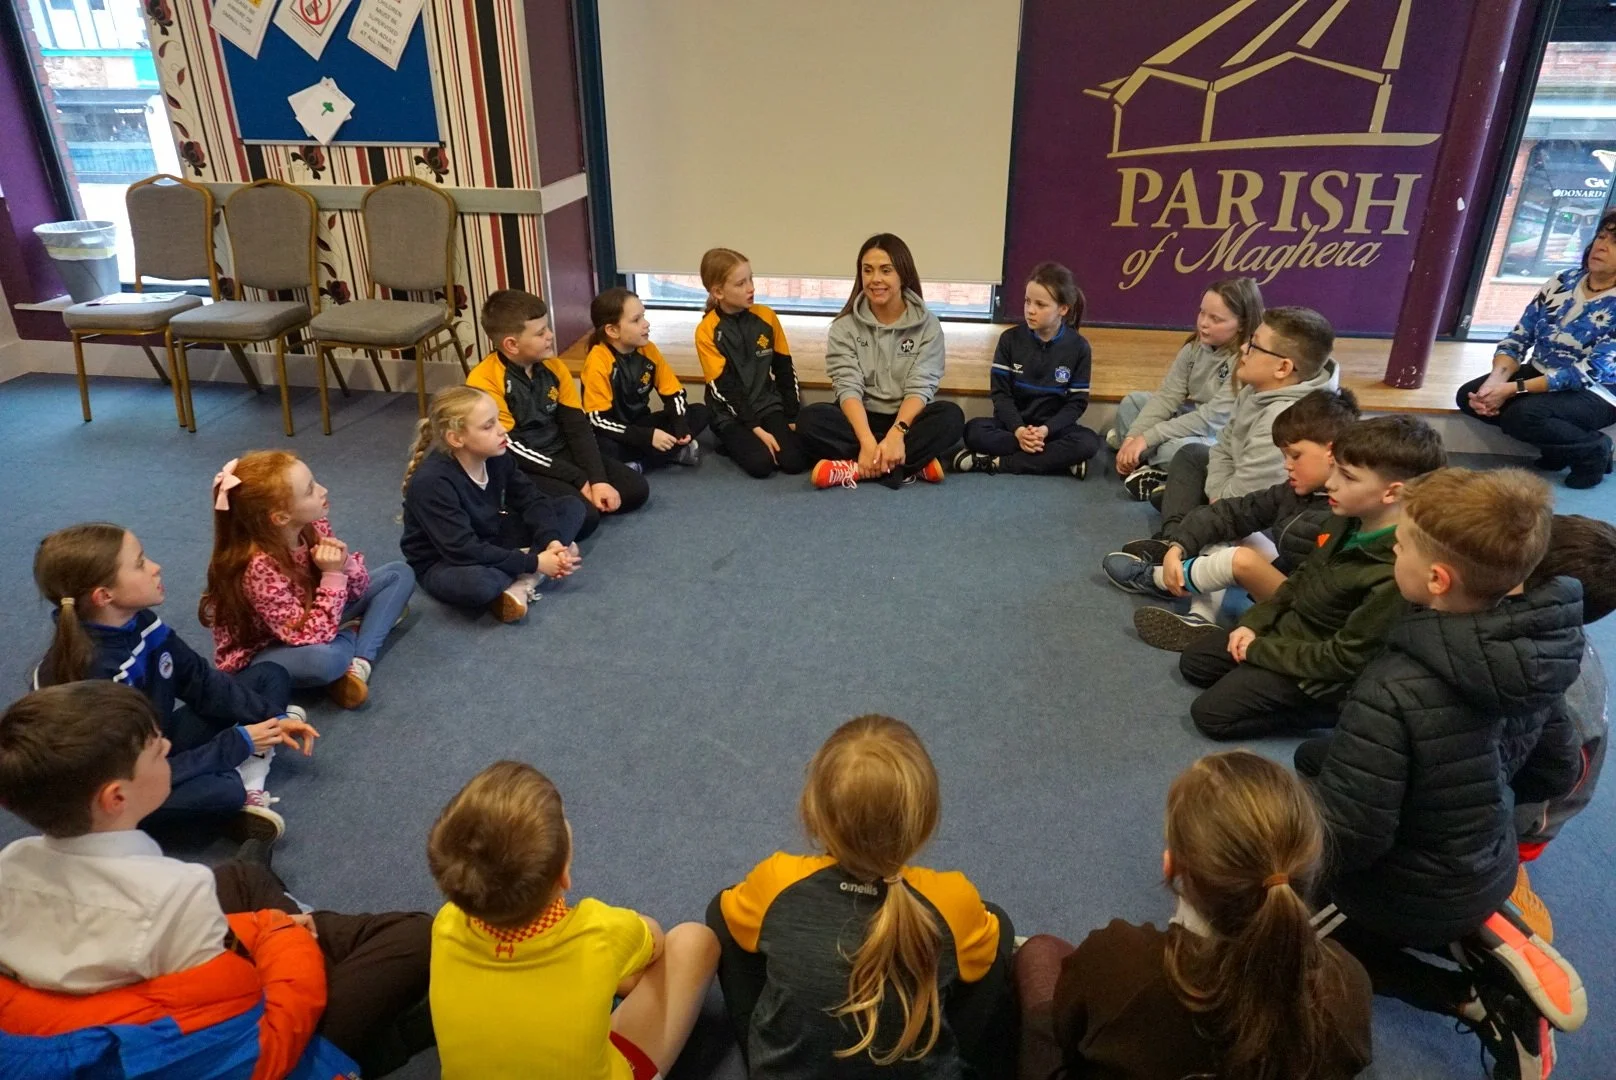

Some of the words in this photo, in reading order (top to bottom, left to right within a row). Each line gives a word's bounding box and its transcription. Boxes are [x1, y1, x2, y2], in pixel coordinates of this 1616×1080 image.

[1111, 167, 1422, 235] PARISH
[1118, 231, 1178, 290] of
[1174, 220, 1383, 286] Maghera
